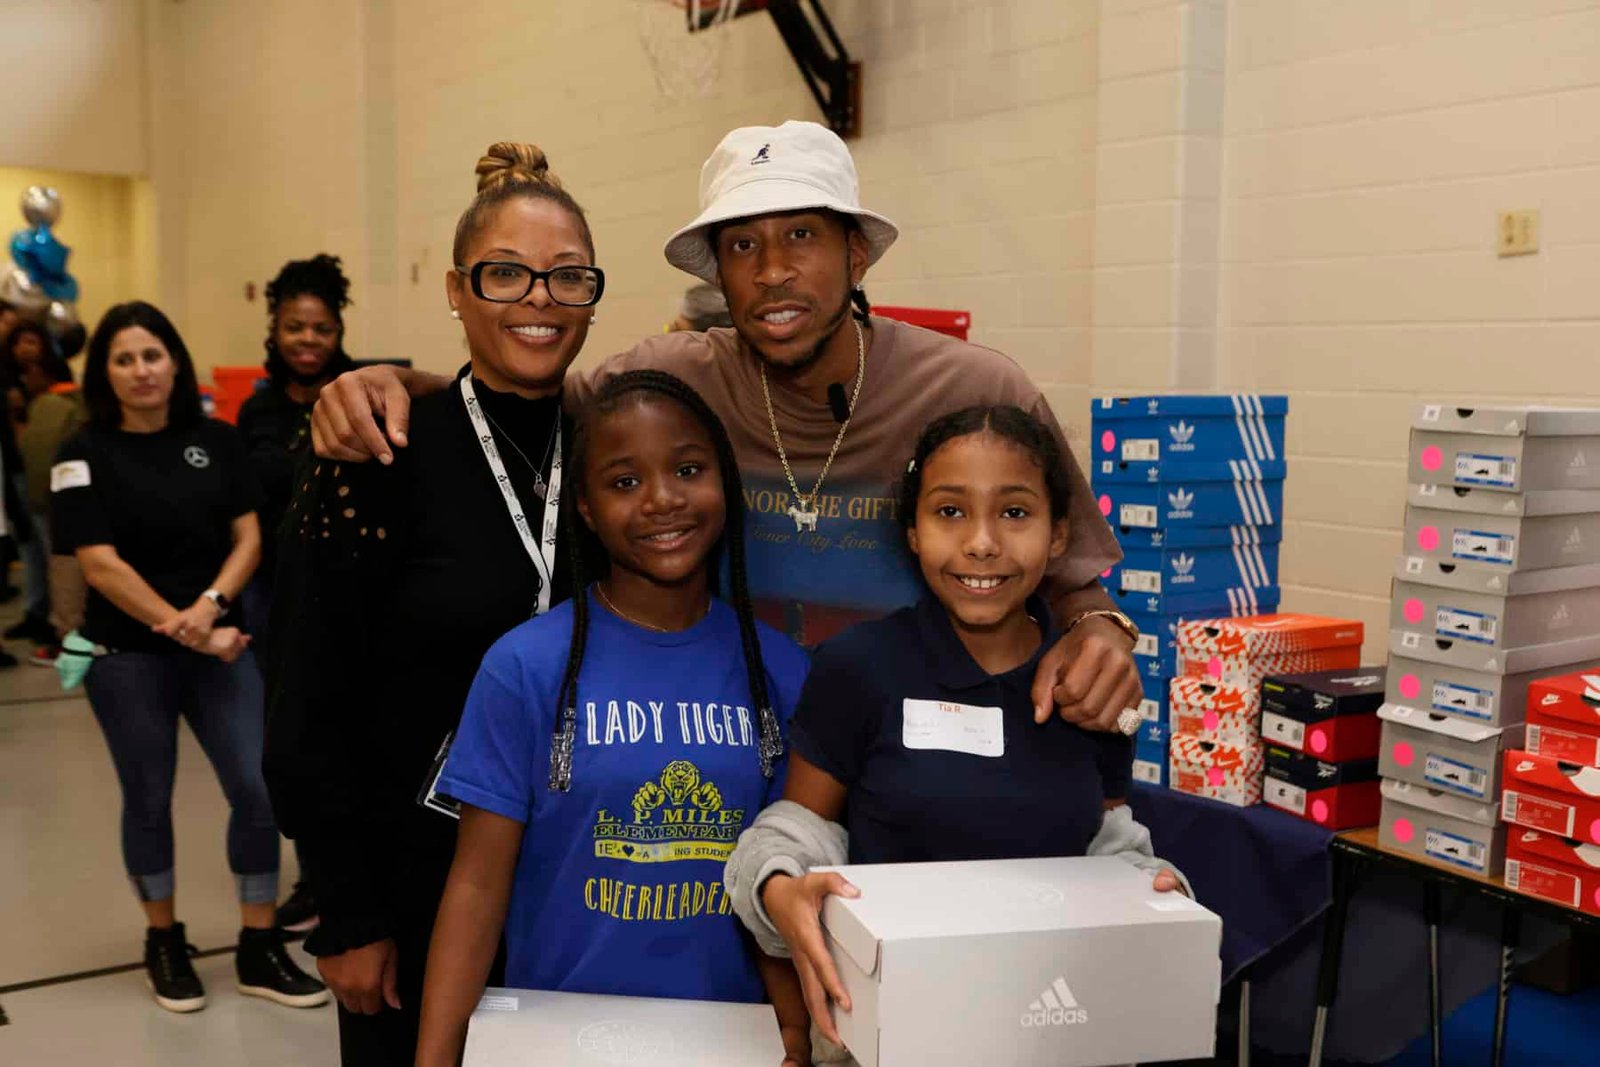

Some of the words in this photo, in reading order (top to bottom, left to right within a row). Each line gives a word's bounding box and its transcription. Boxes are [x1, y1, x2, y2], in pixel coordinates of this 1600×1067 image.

[742, 490, 791, 514] NOR
[847, 496, 898, 520] GIFT
[586, 700, 665, 746] LADY
[676, 702, 753, 747] TIGER
[597, 809, 621, 823] L.
[633, 810, 653, 825] P.
[662, 809, 744, 825] MILES
[593, 824, 741, 841] ELEMENTAR
[1020, 1007, 1089, 1027] adidas
